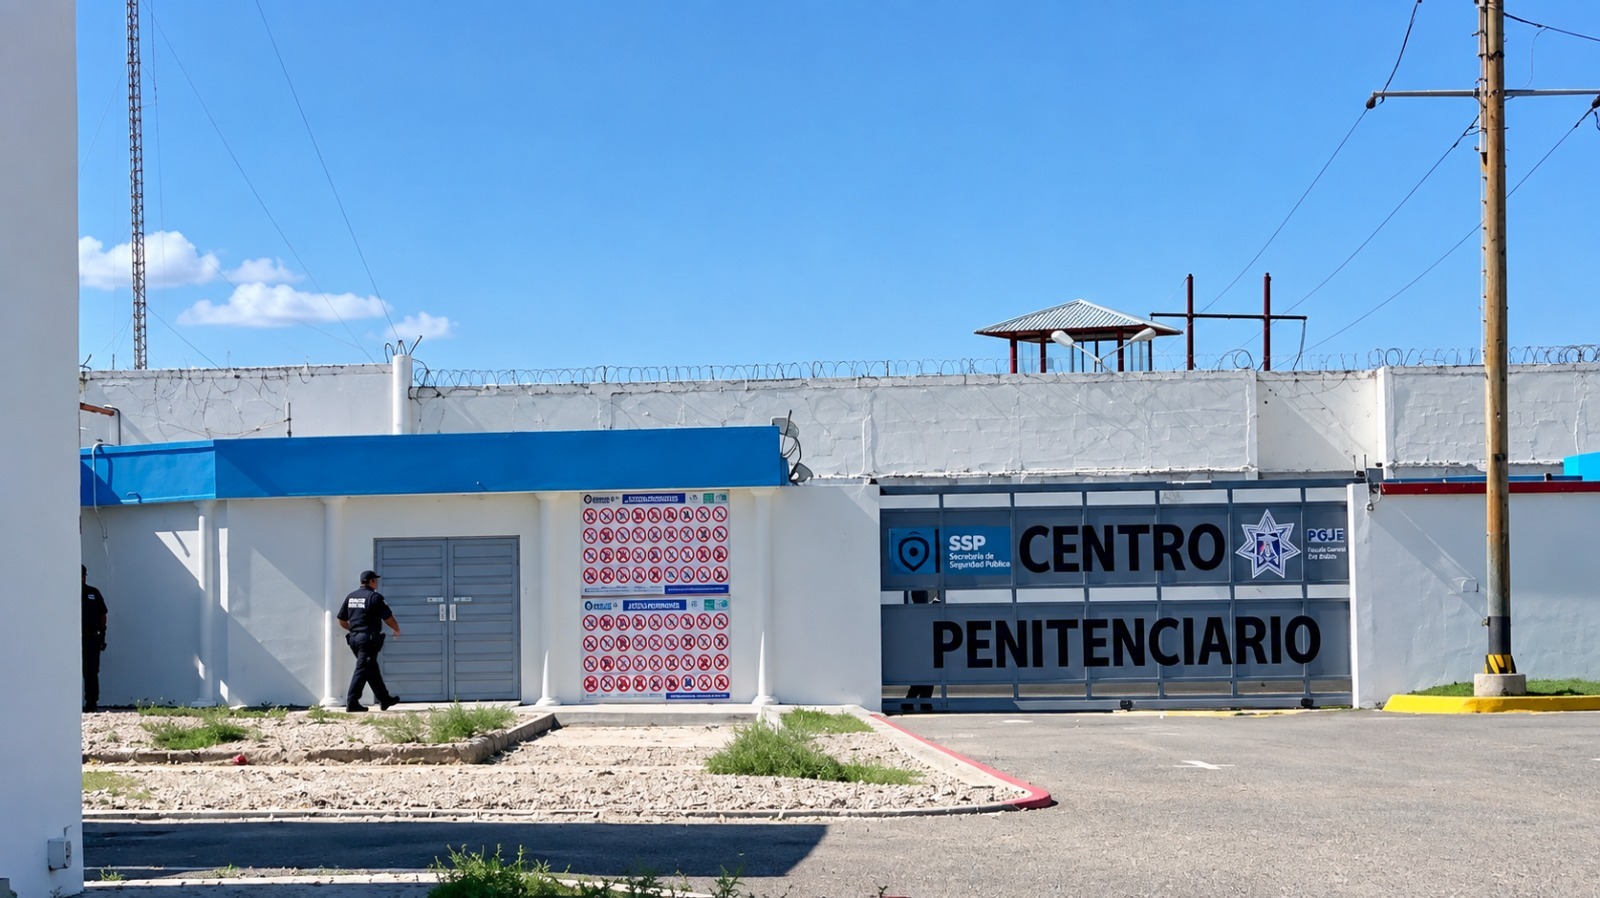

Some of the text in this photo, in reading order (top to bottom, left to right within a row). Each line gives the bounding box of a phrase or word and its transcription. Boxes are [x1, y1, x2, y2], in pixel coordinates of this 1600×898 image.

[949, 535, 986, 551] SSP
[1307, 528, 1344, 542] PGJE
[985, 552, 994, 560] de
[1020, 524, 1225, 573] CENTRO
[933, 616, 1320, 668] PENITENCIARIO
